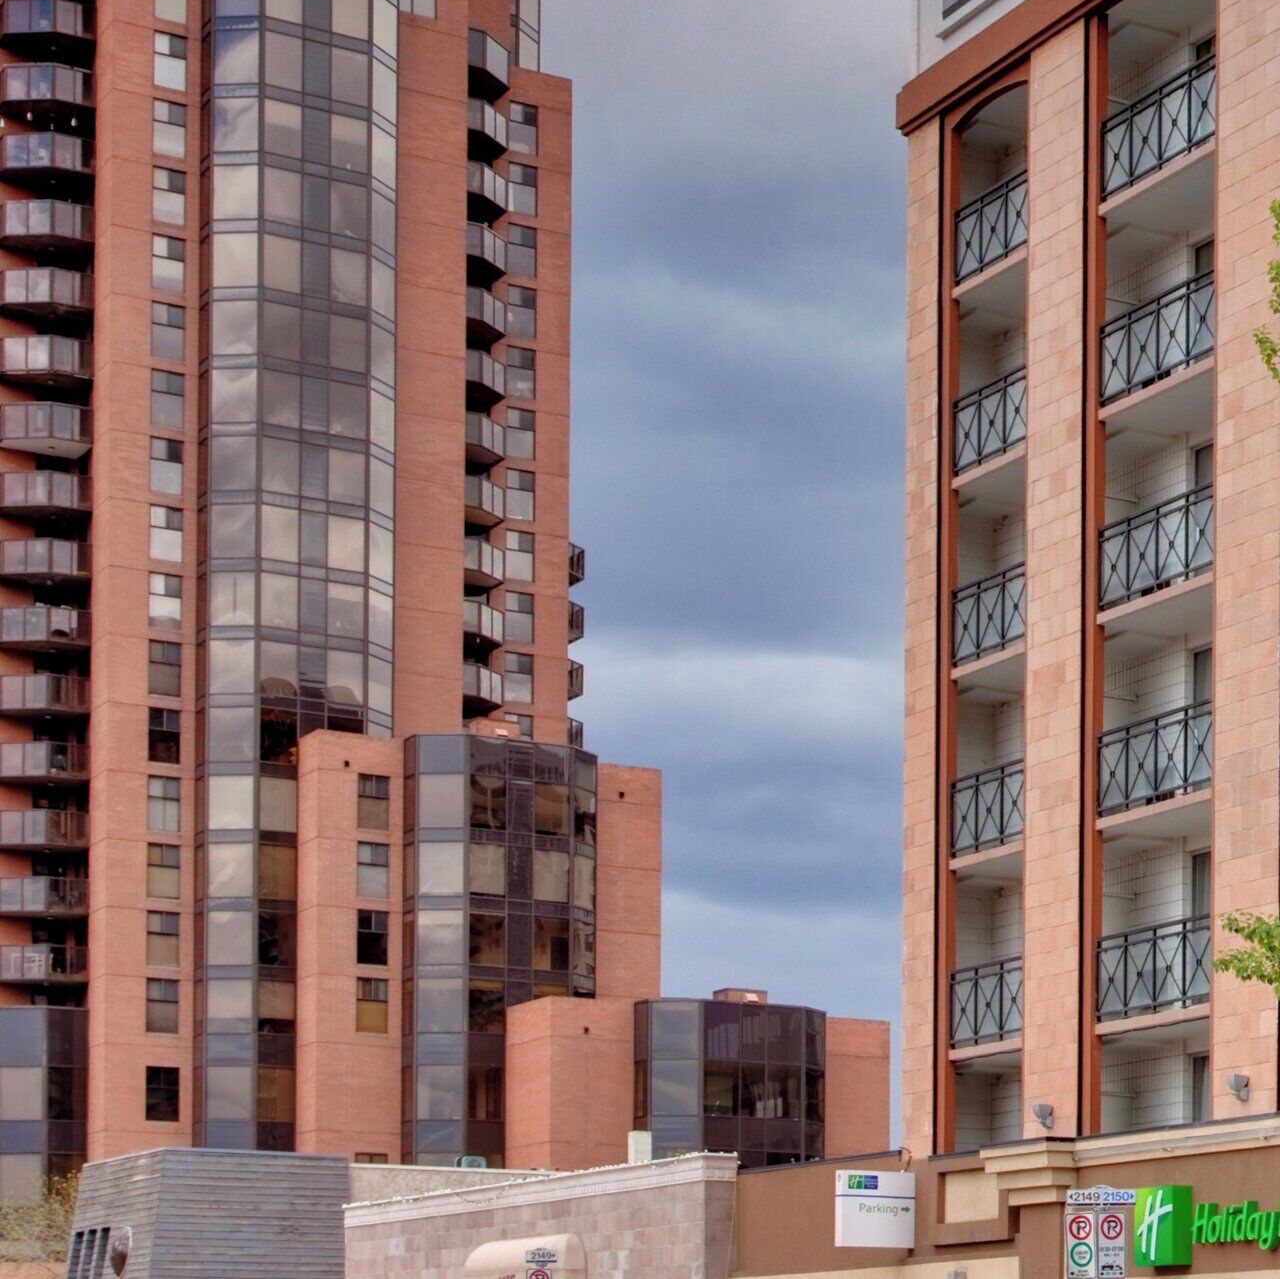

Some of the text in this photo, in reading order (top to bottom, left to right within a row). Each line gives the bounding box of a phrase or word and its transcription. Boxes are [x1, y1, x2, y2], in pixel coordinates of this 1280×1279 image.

[1073, 1191, 1130, 1202] 2149 2150
[859, 1203, 899, 1217] Parking
[1191, 1200, 1280, 1251] Holiday
[531, 1251, 552, 1260] 2149
